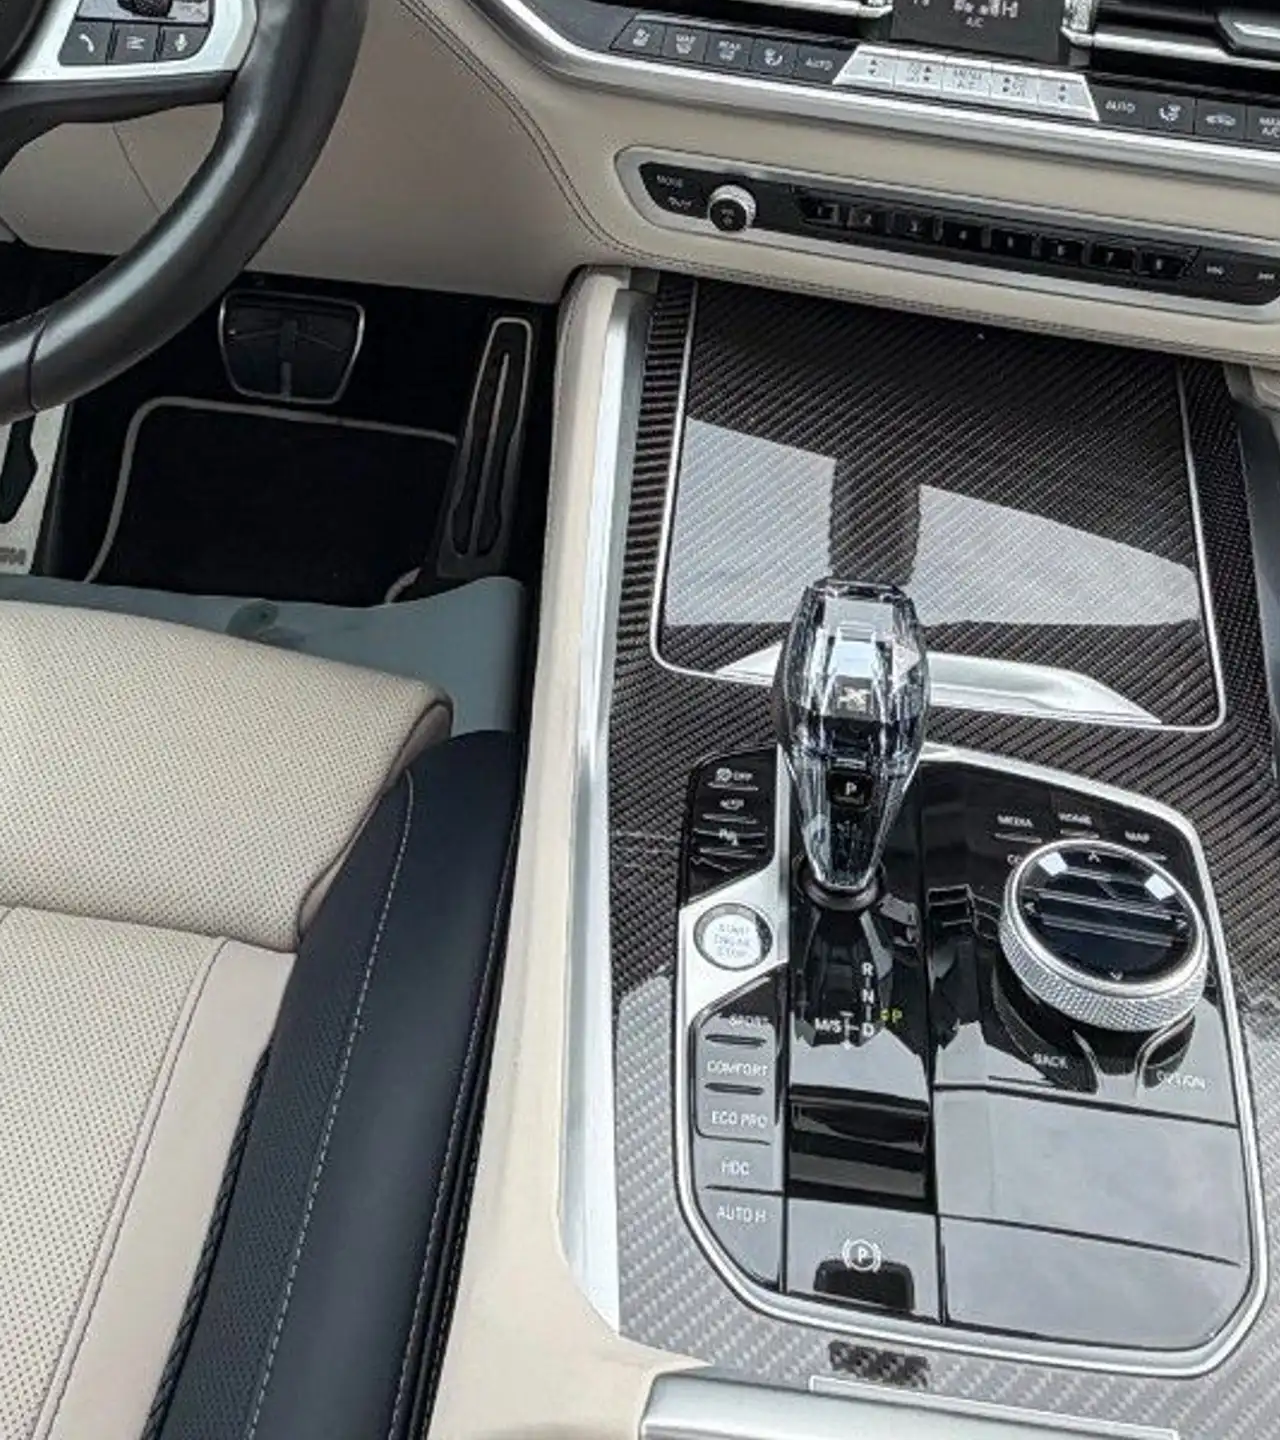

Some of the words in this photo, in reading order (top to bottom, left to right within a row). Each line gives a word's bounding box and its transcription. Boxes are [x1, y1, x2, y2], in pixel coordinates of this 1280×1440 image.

[844, 781, 857, 796] P
[996, 814, 1034, 828] MEDIA
[861, 962, 874, 976] R
[861, 989, 875, 1004] N
[891, 1008, 903, 1023] P
[862, 1023, 875, 1037] D
[706, 1060, 769, 1077] COMFORT
[1032, 1053, 1069, 1069] BACK
[711, 1110, 738, 1126] ECO
[740, 1113, 769, 1129] PRO
[721, 1160, 751, 1176] HDC
[716, 1206, 753, 1222] AUTO
[857, 1247, 869, 1263] P
